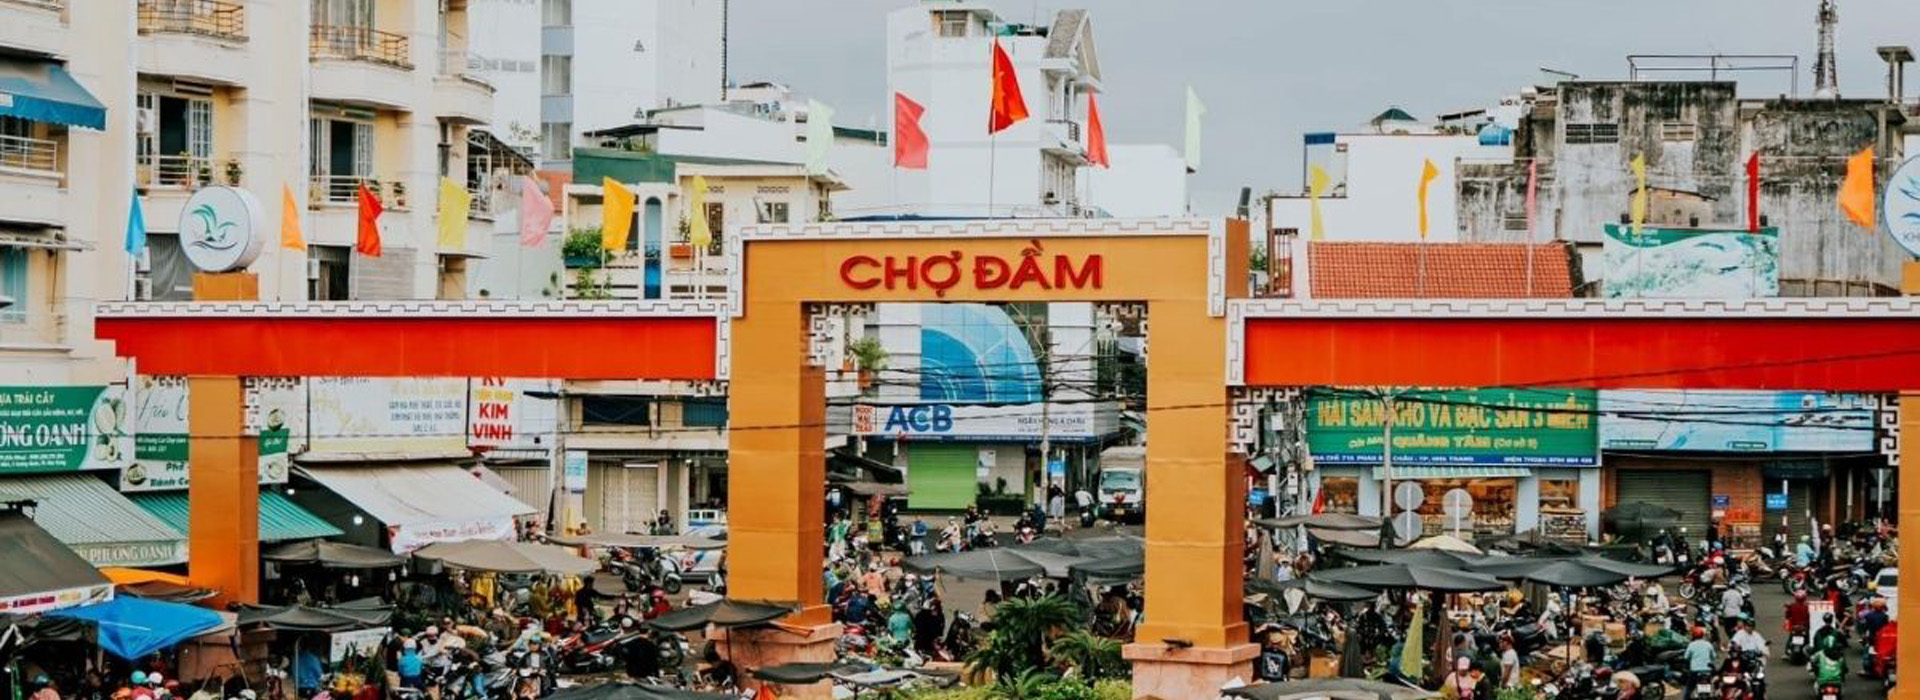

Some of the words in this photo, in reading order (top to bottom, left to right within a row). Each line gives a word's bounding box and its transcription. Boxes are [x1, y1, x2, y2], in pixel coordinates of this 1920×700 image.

[841, 250, 962, 298] CHỢ
[973, 240, 1103, 290] ĐẦM
[35, 391, 55, 404] CÂY
[479, 403, 508, 419] KIM
[884, 405, 953, 432] ACB
[1038, 416, 1059, 425] HNG
[1494, 392, 1530, 429] SẢN
[36, 423, 86, 447] OANH
[473, 424, 512, 440] VINH
